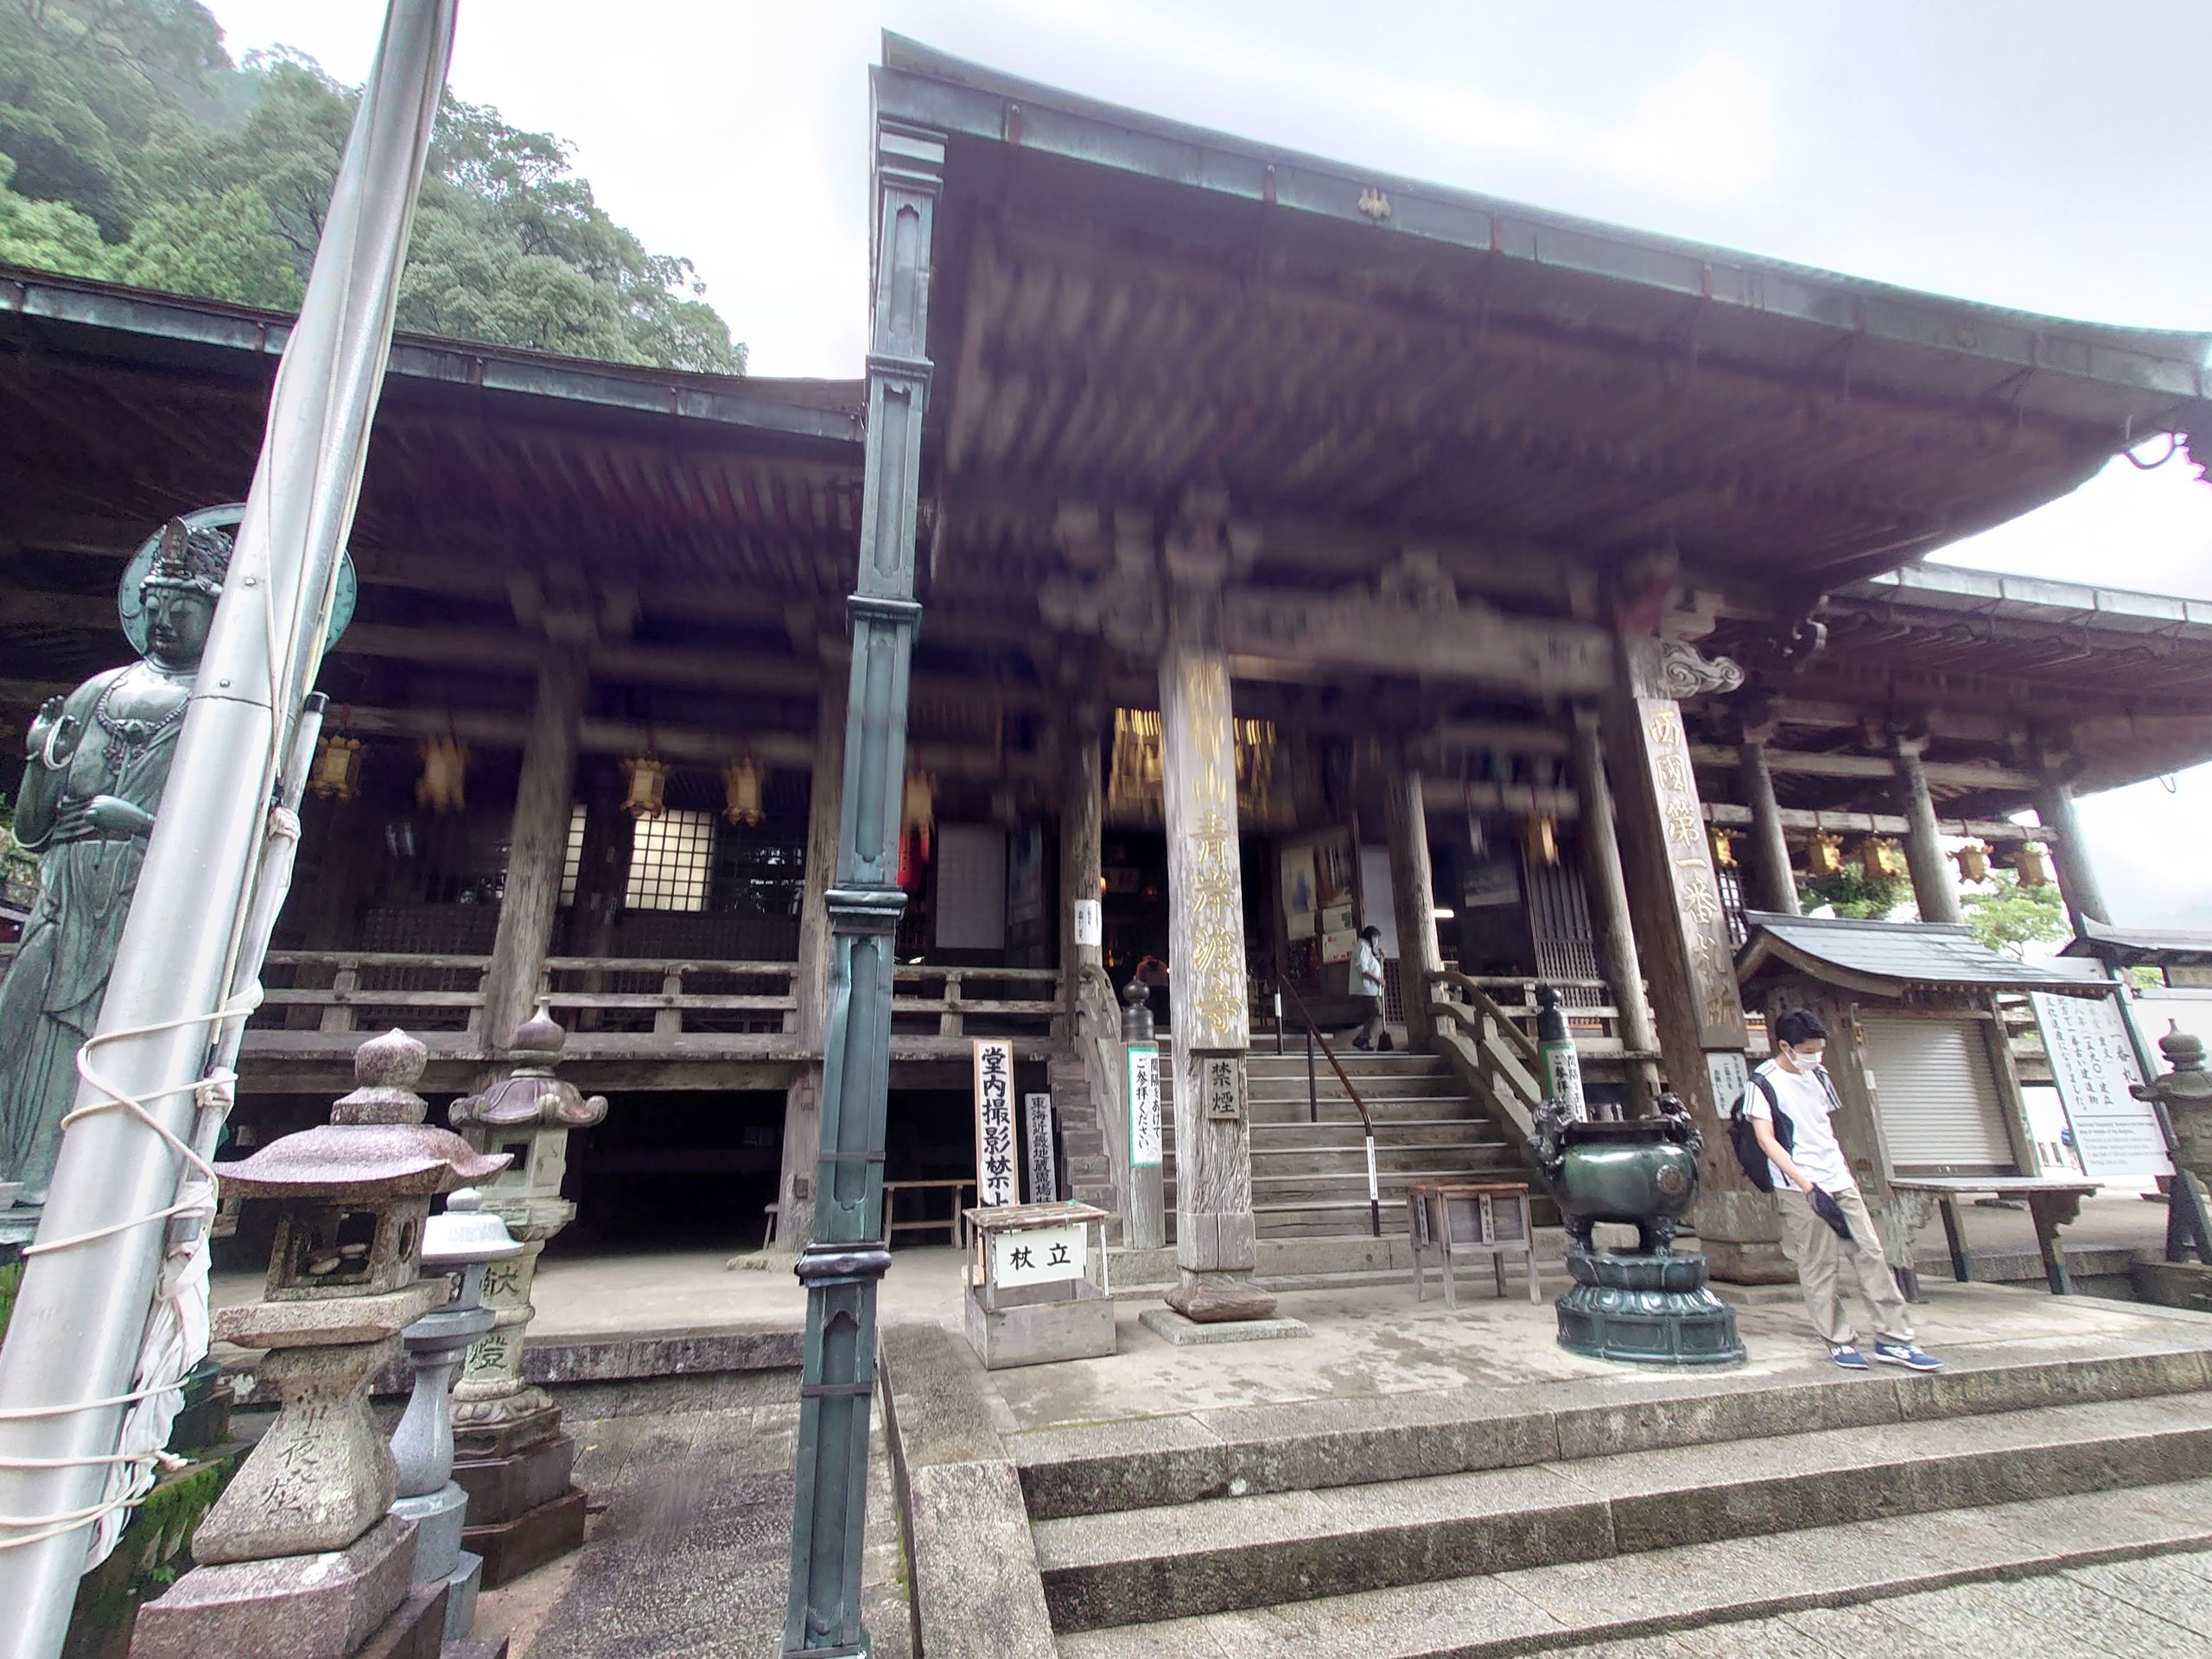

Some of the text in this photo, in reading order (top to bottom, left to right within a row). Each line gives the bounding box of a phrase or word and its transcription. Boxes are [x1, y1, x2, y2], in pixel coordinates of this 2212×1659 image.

[1186, 661, 1243, 1035] 山青岸渡寺
[1211, 1061, 1235, 1114] 禁煙
[1010, 1243, 1071, 1272] 杖立
